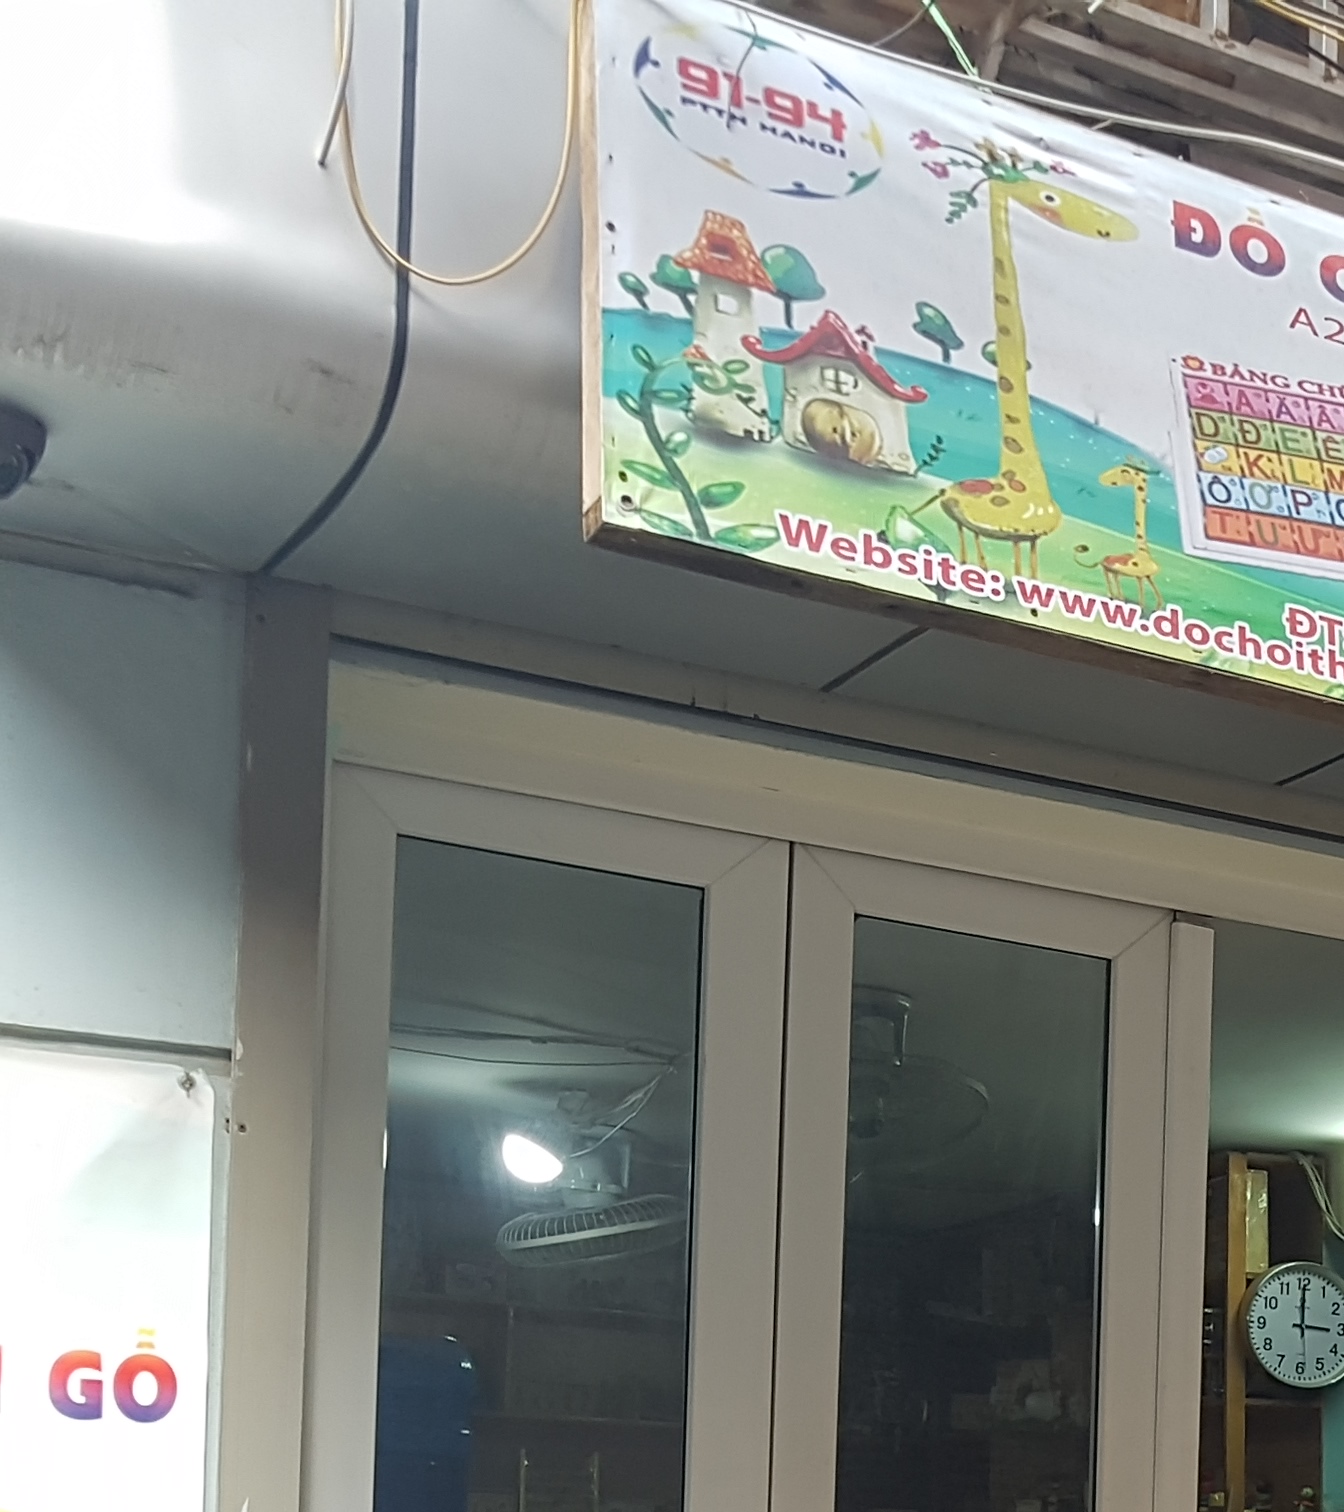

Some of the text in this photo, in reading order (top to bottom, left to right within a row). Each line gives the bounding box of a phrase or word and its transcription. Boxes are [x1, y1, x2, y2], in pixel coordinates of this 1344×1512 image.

[677, 56, 848, 142] 91-94
[680, 95, 847, 158] PTTH HANOI
[1171, 199, 1286, 277] ĐỒ
[1208, 362, 1291, 389] BẢNG
[778, 512, 1006, 598] Website:
[1279, 1281, 1290, 1295] 11
[1297, 1277, 1311, 1291] 12
[1263, 1296, 1278, 1310] 10
[1331, 1302, 1340, 1316] 2
[1257, 1316, 1266, 1330] 9
[1263, 1337, 1273, 1351] 8
[1329, 1343, 1338, 1357] 4
[1276, 1353, 1286, 1368] 7
[1315, 1357, 1325, 1371] 5
[49, 1327, 177, 1423] GỖ
[1295, 1361, 1306, 1375] 6
